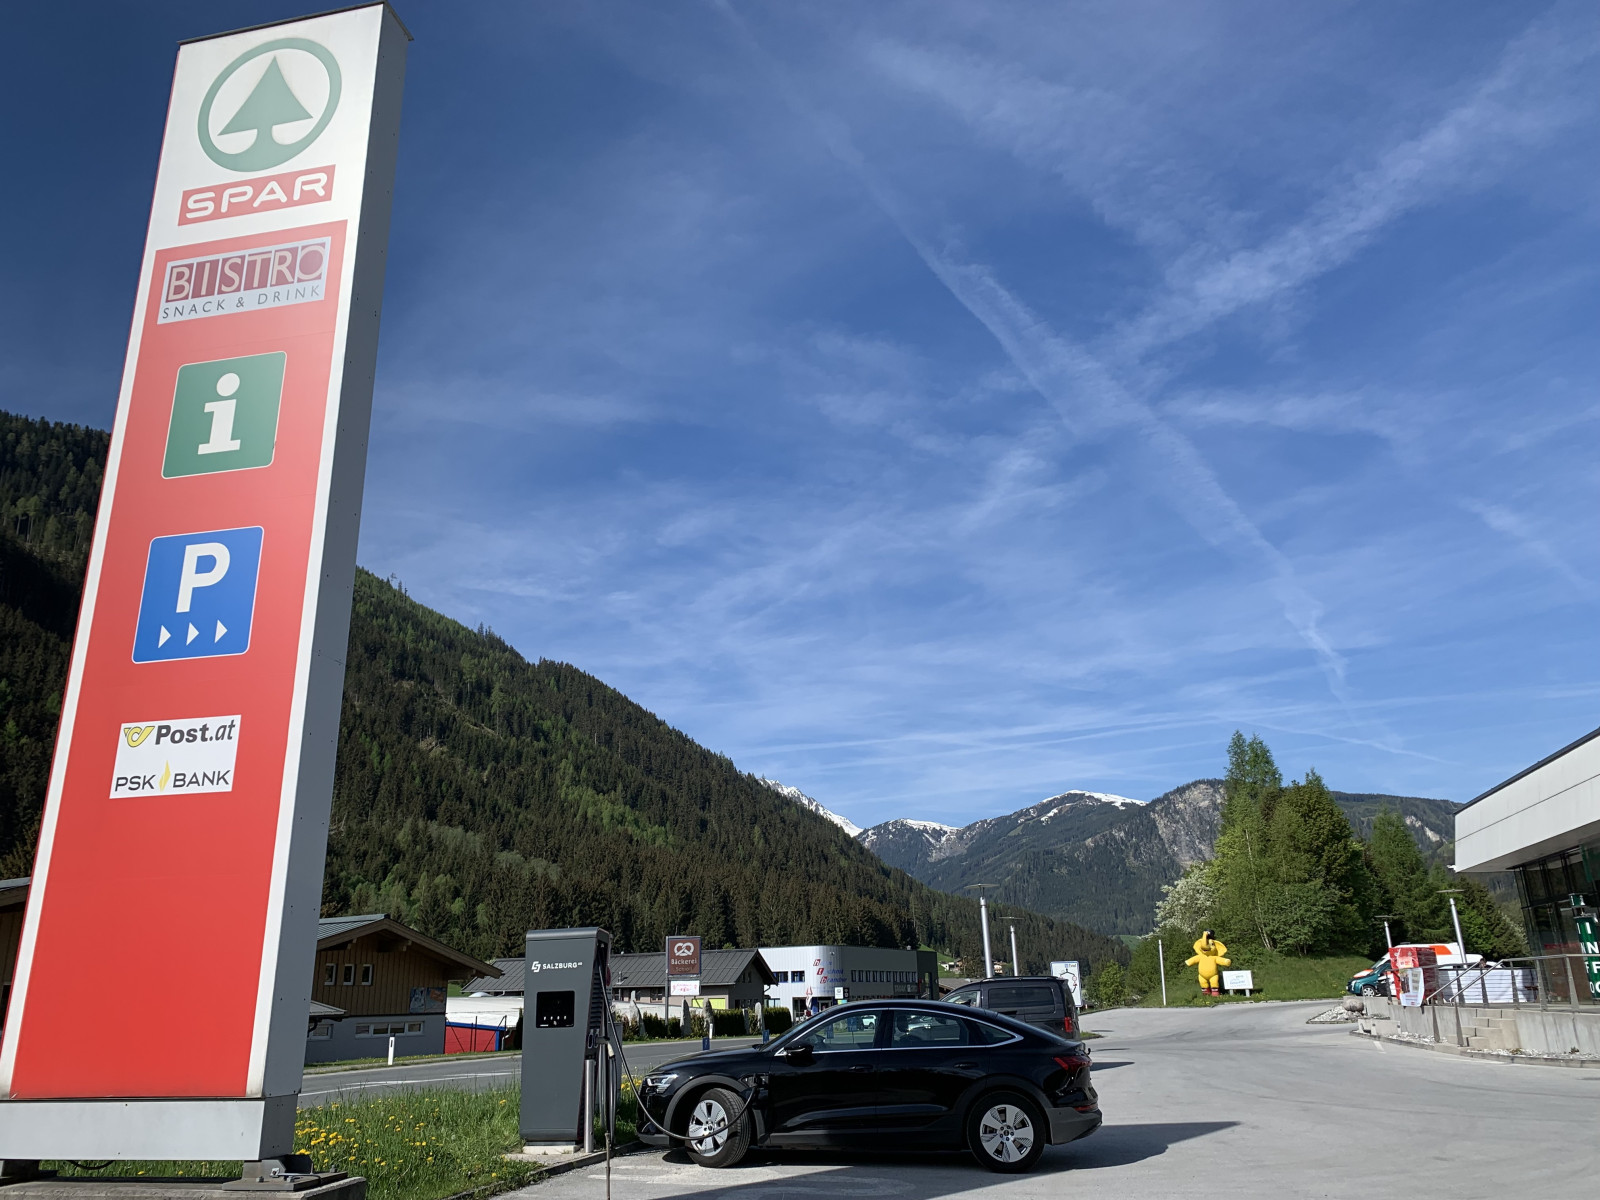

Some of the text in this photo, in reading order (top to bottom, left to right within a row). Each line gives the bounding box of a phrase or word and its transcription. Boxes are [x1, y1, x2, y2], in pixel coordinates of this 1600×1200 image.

[185, 172, 328, 219] SPAR
[167, 245, 325, 301] BISTRO
[162, 284, 320, 319] SNACK & DRINK
[176, 542, 231, 613] P
[155, 719, 235, 745] Post.at
[114, 769, 231, 792] PSK BANK
[542, 962, 578, 970] SALZBURG
[671, 957, 697, 965] Bäckerei
